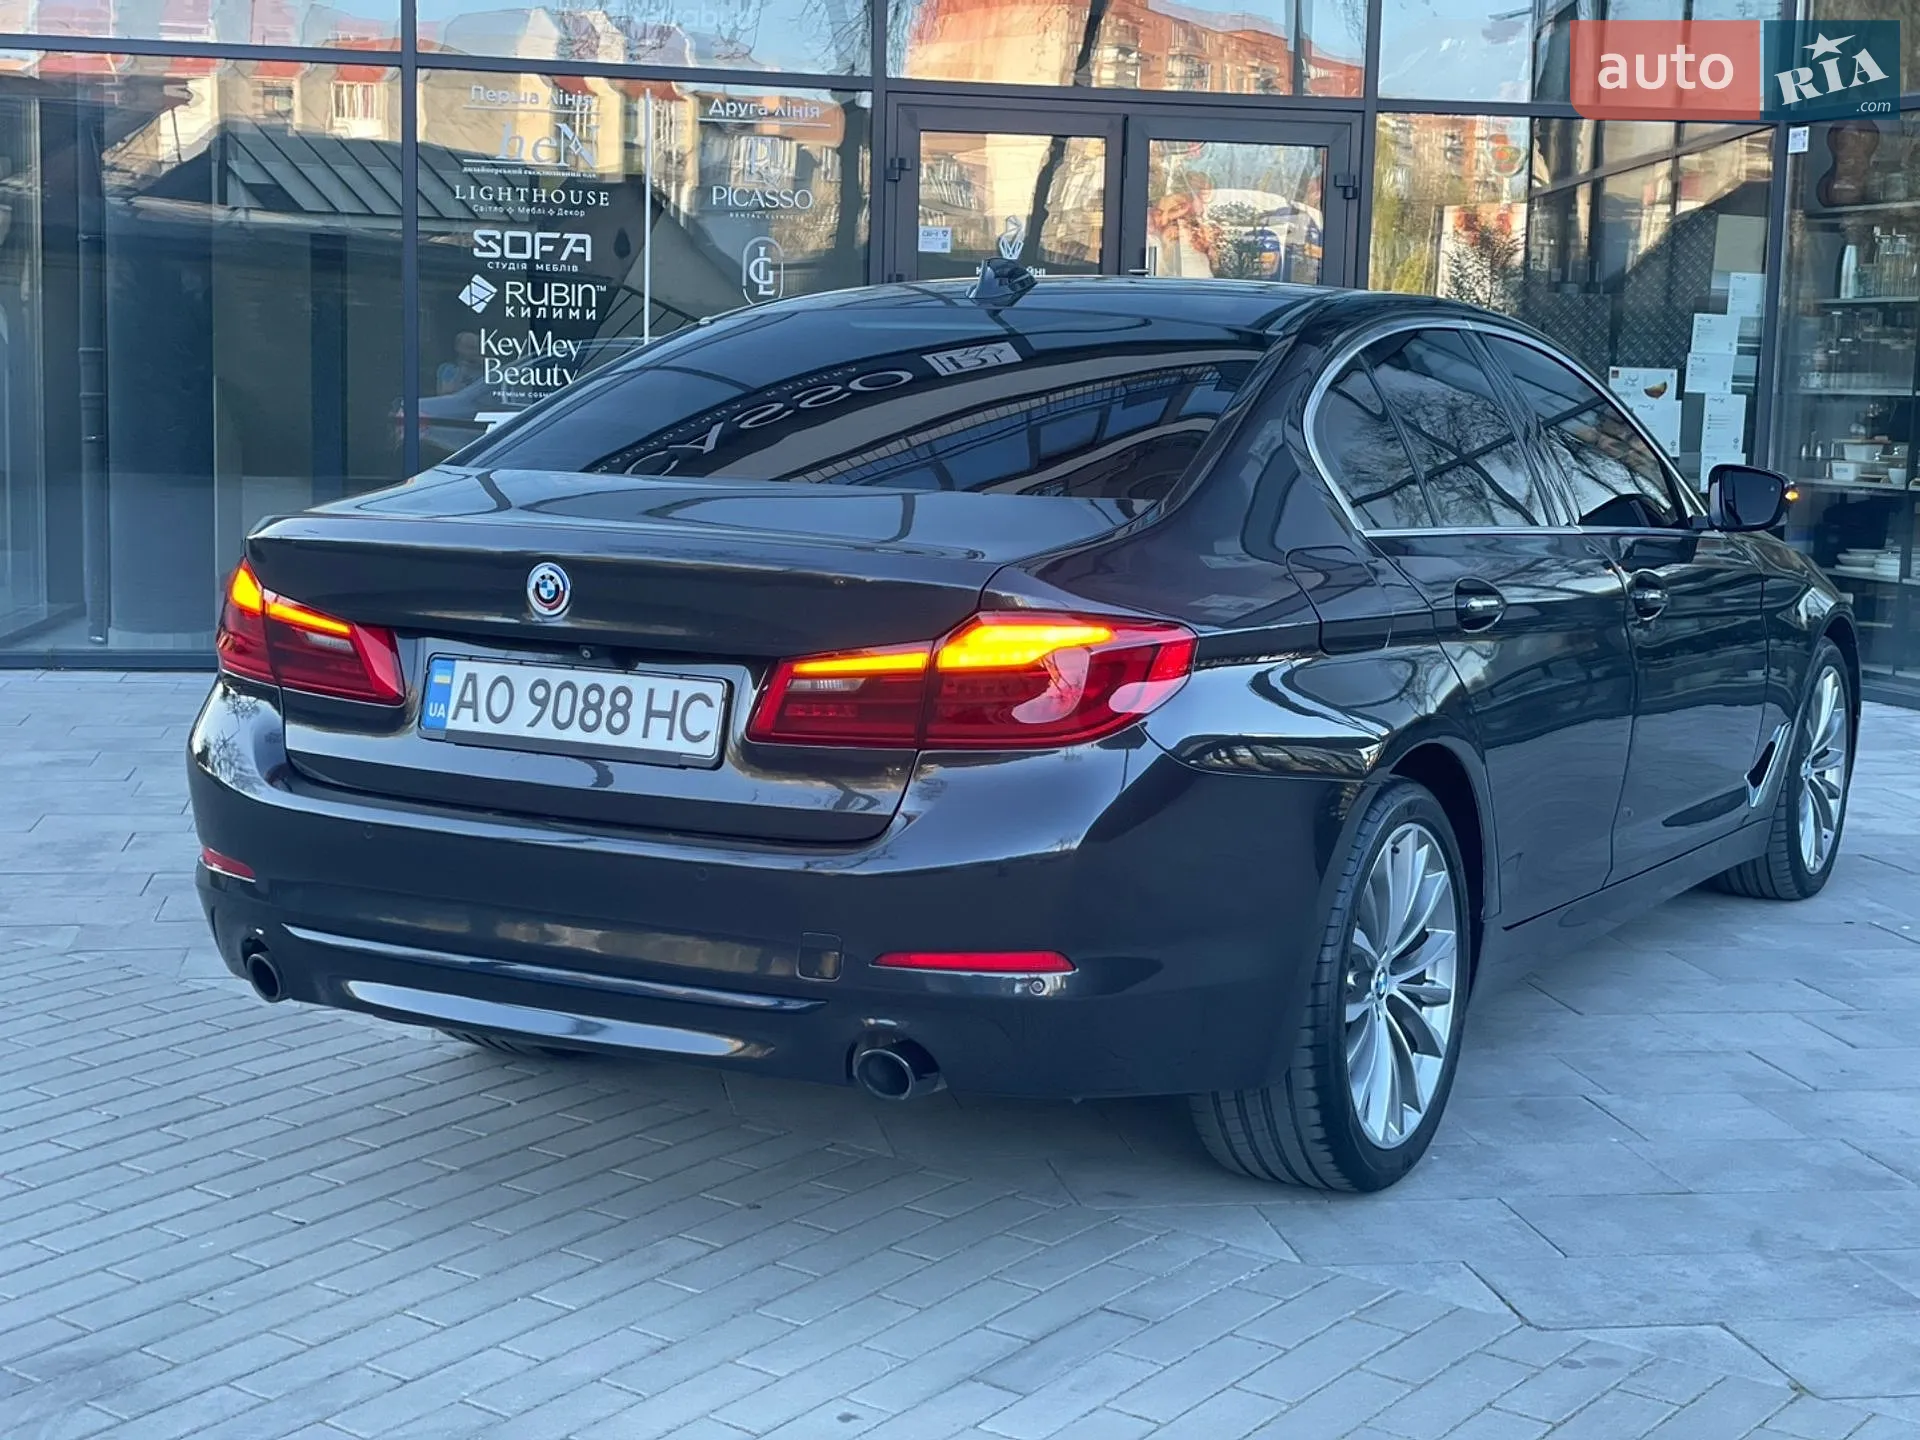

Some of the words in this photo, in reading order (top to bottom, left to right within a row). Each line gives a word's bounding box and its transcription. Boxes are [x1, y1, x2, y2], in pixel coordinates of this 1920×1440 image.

[708, 98, 768, 118] Друга
[774, 101, 820, 118] лінія
[455, 185, 610, 206] LIGHTHOUSE
[712, 185, 813, 209] PICASSO
[473, 229, 592, 262] SOFA
[487, 261, 528, 271] СТУДІЯ
[536, 264, 579, 272] МЕБЛІВ
[505, 305, 596, 320] КИЛИМИ
[480, 328, 583, 362] KeyMey
[484, 357, 578, 387] Beauty
[429, 702, 446, 718] UA
[451, 672, 515, 725] AO
[525, 677, 634, 736] 9088
[641, 687, 715, 744] HC
